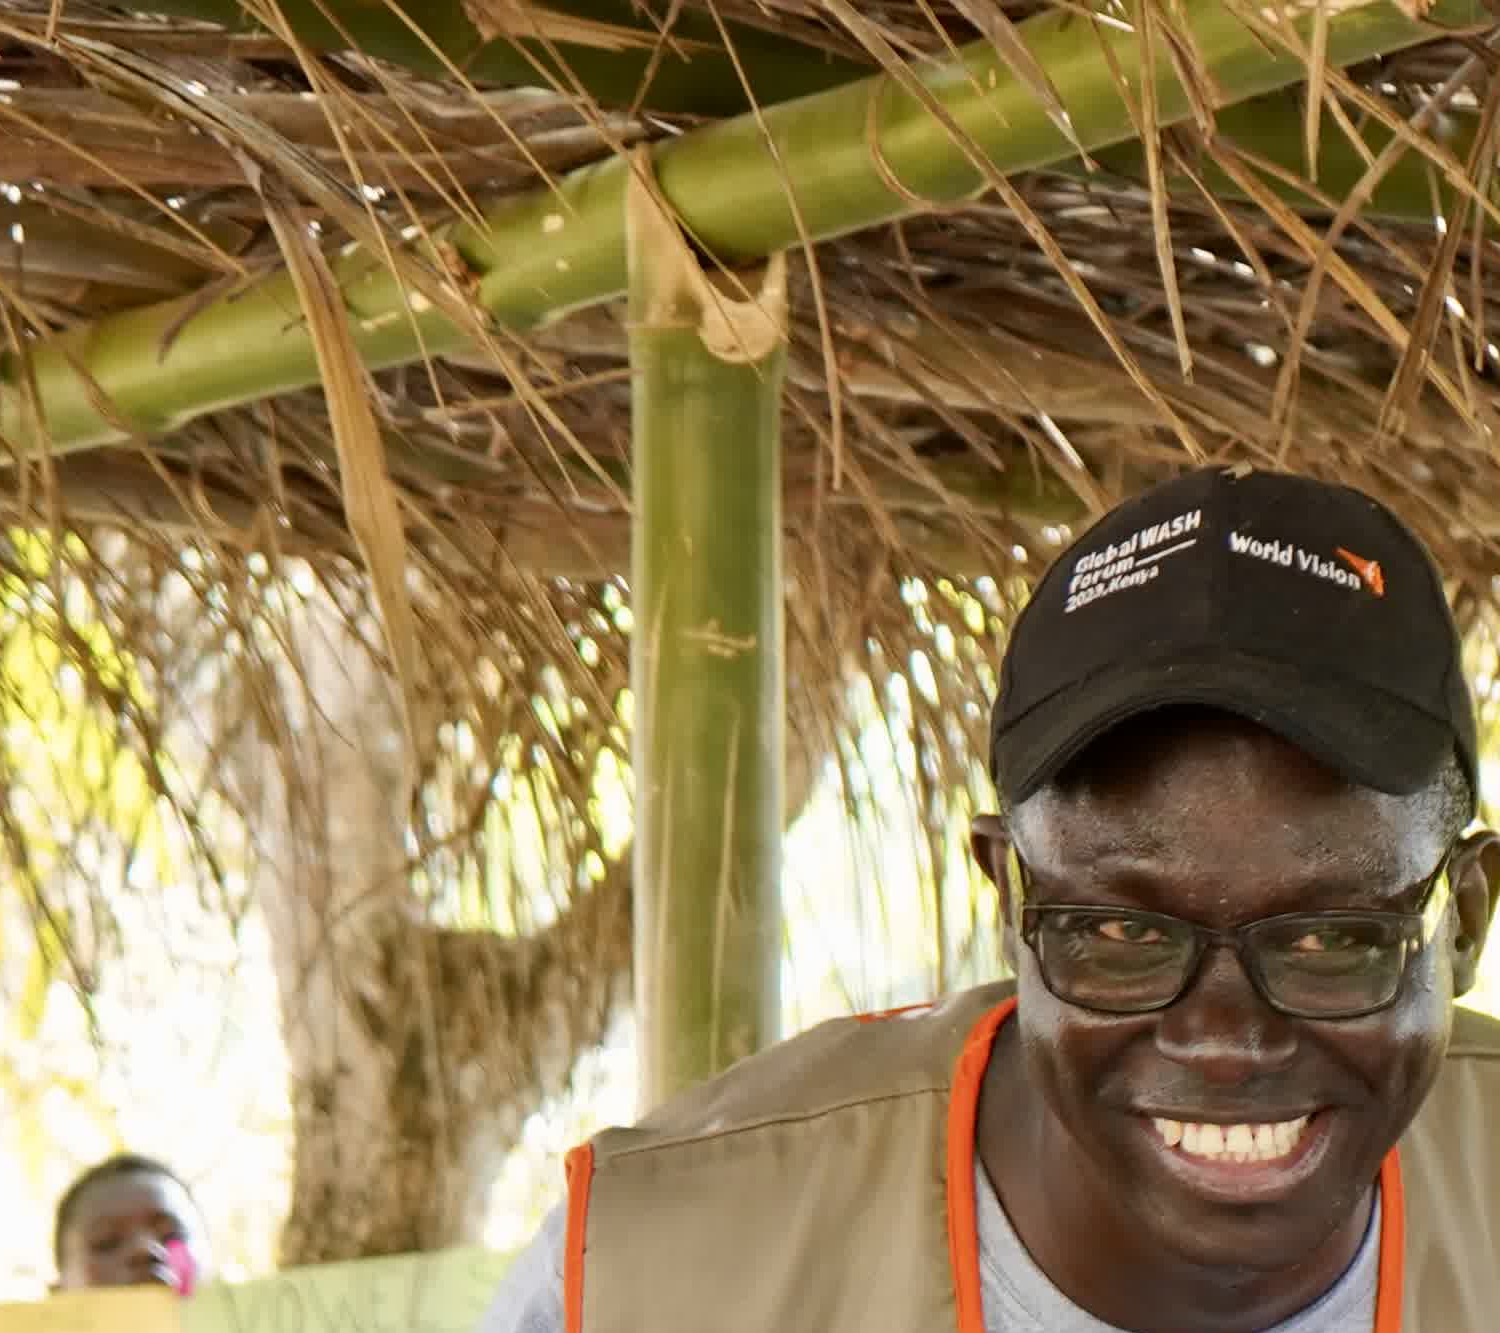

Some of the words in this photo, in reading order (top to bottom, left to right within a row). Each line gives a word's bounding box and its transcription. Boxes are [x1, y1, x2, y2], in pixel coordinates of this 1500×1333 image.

[1075, 533, 1139, 574] Global
[1140, 509, 1201, 549] WASH
[1230, 531, 1293, 566] World
[1297, 549, 1361, 590] Vision
[1069, 556, 1135, 594] Forum
